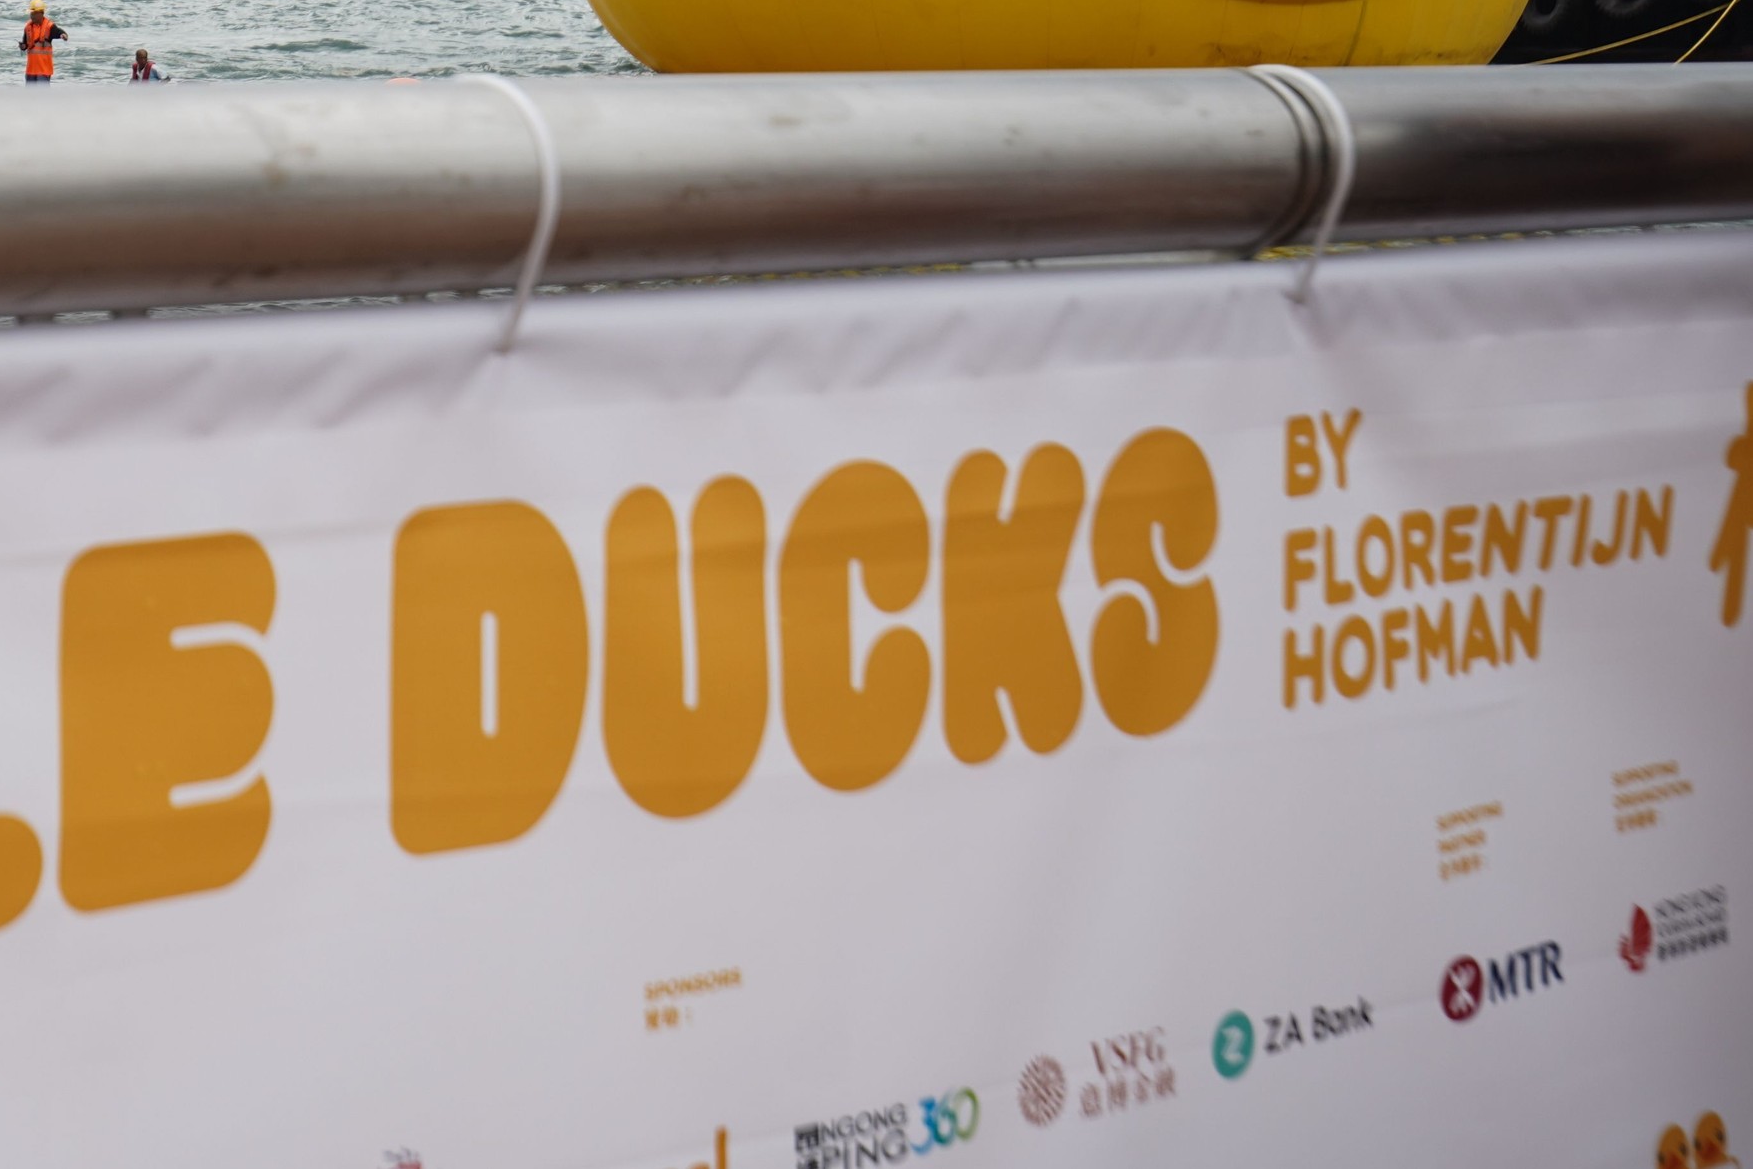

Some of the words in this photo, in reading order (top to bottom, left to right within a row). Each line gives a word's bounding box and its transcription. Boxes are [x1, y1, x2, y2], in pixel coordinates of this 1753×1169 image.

[1284, 407, 1362, 498] BY
[1283, 485, 1674, 612] FLORENTIJN
[389, 427, 1220, 857] DUCKS
[1282, 585, 1544, 710] HOFMAN
[1487, 940, 1564, 1003] MTR
[1263, 1013, 1304, 1054] ZA
[1312, 995, 1374, 1041] Bank
[819, 1103, 908, 1142] NGONG
[823, 1128, 909, 1169] PING
[911, 1086, 981, 1156] 360
